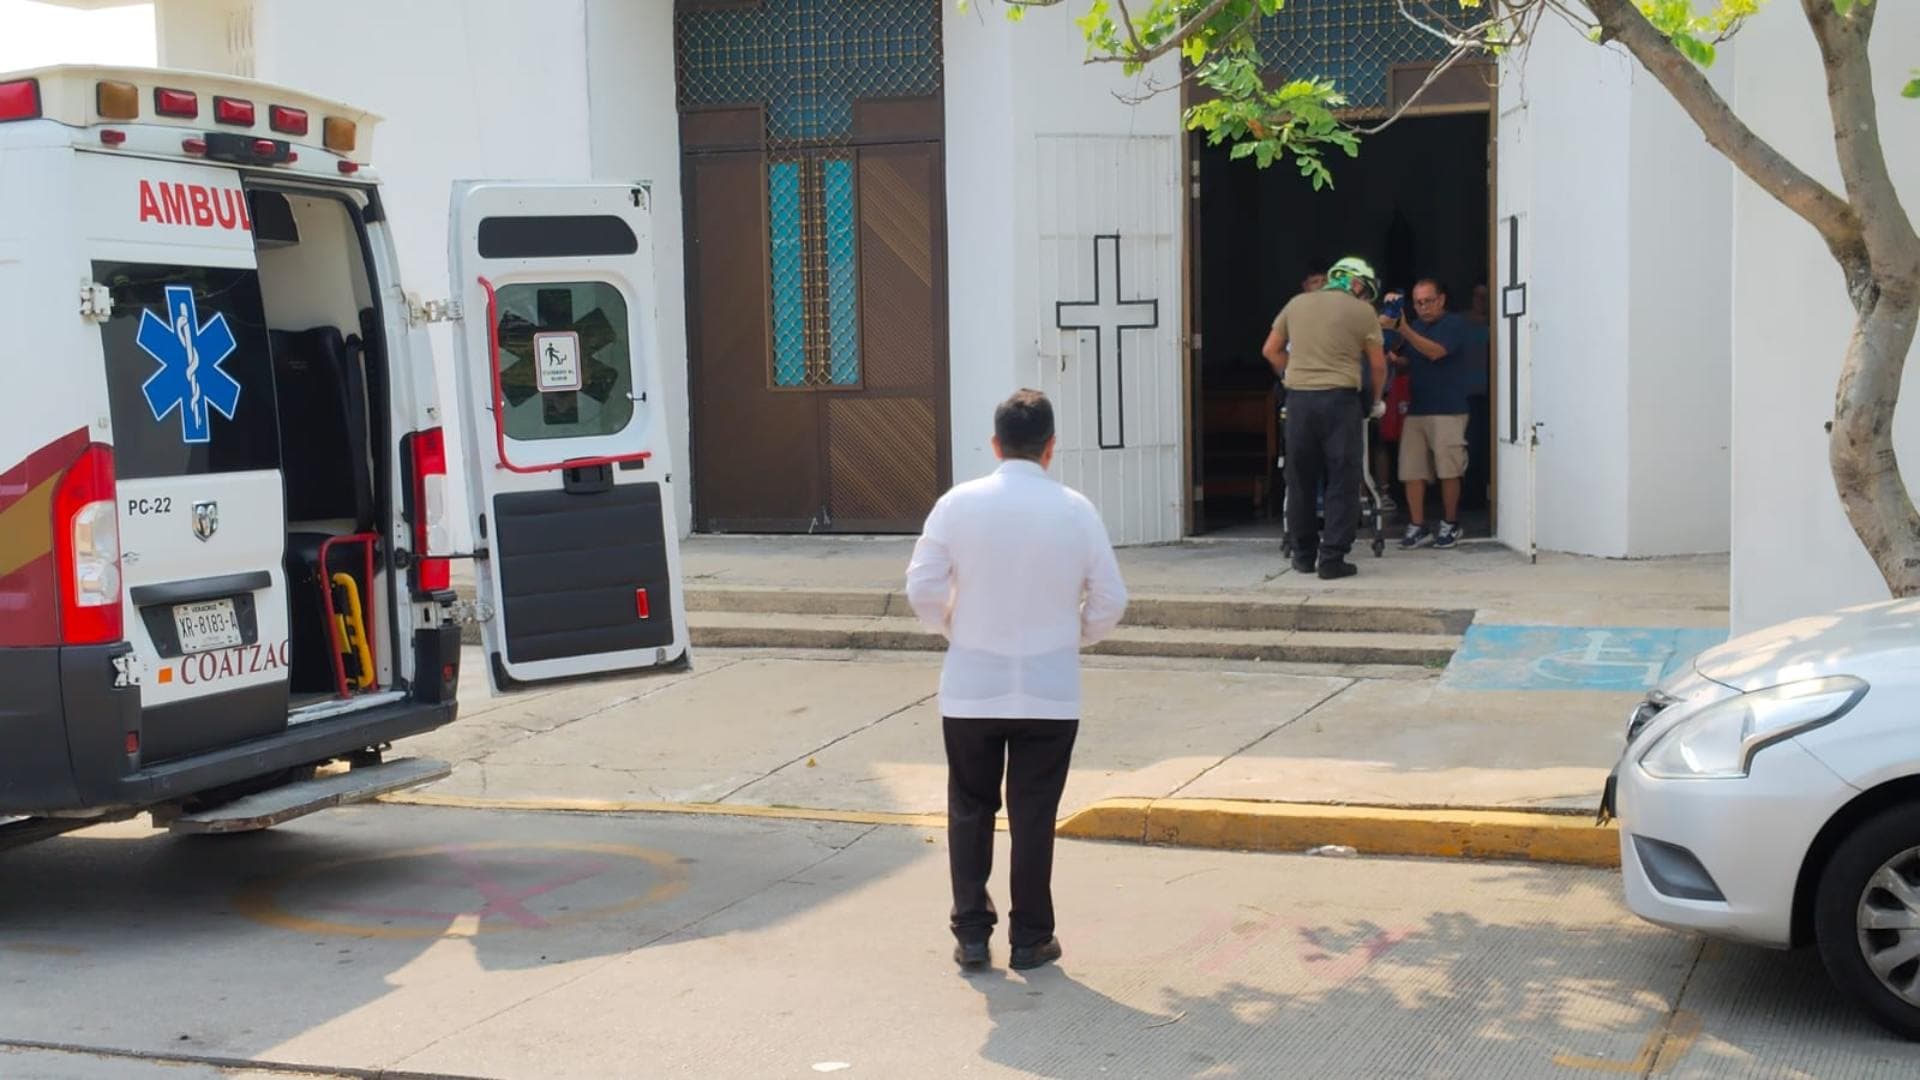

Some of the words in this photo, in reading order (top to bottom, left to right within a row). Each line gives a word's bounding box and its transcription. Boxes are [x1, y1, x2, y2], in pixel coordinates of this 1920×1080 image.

[139, 179, 252, 231] AMBUL
[128, 497, 172, 516] PC-22
[179, 611, 239, 639] XR-8183-A
